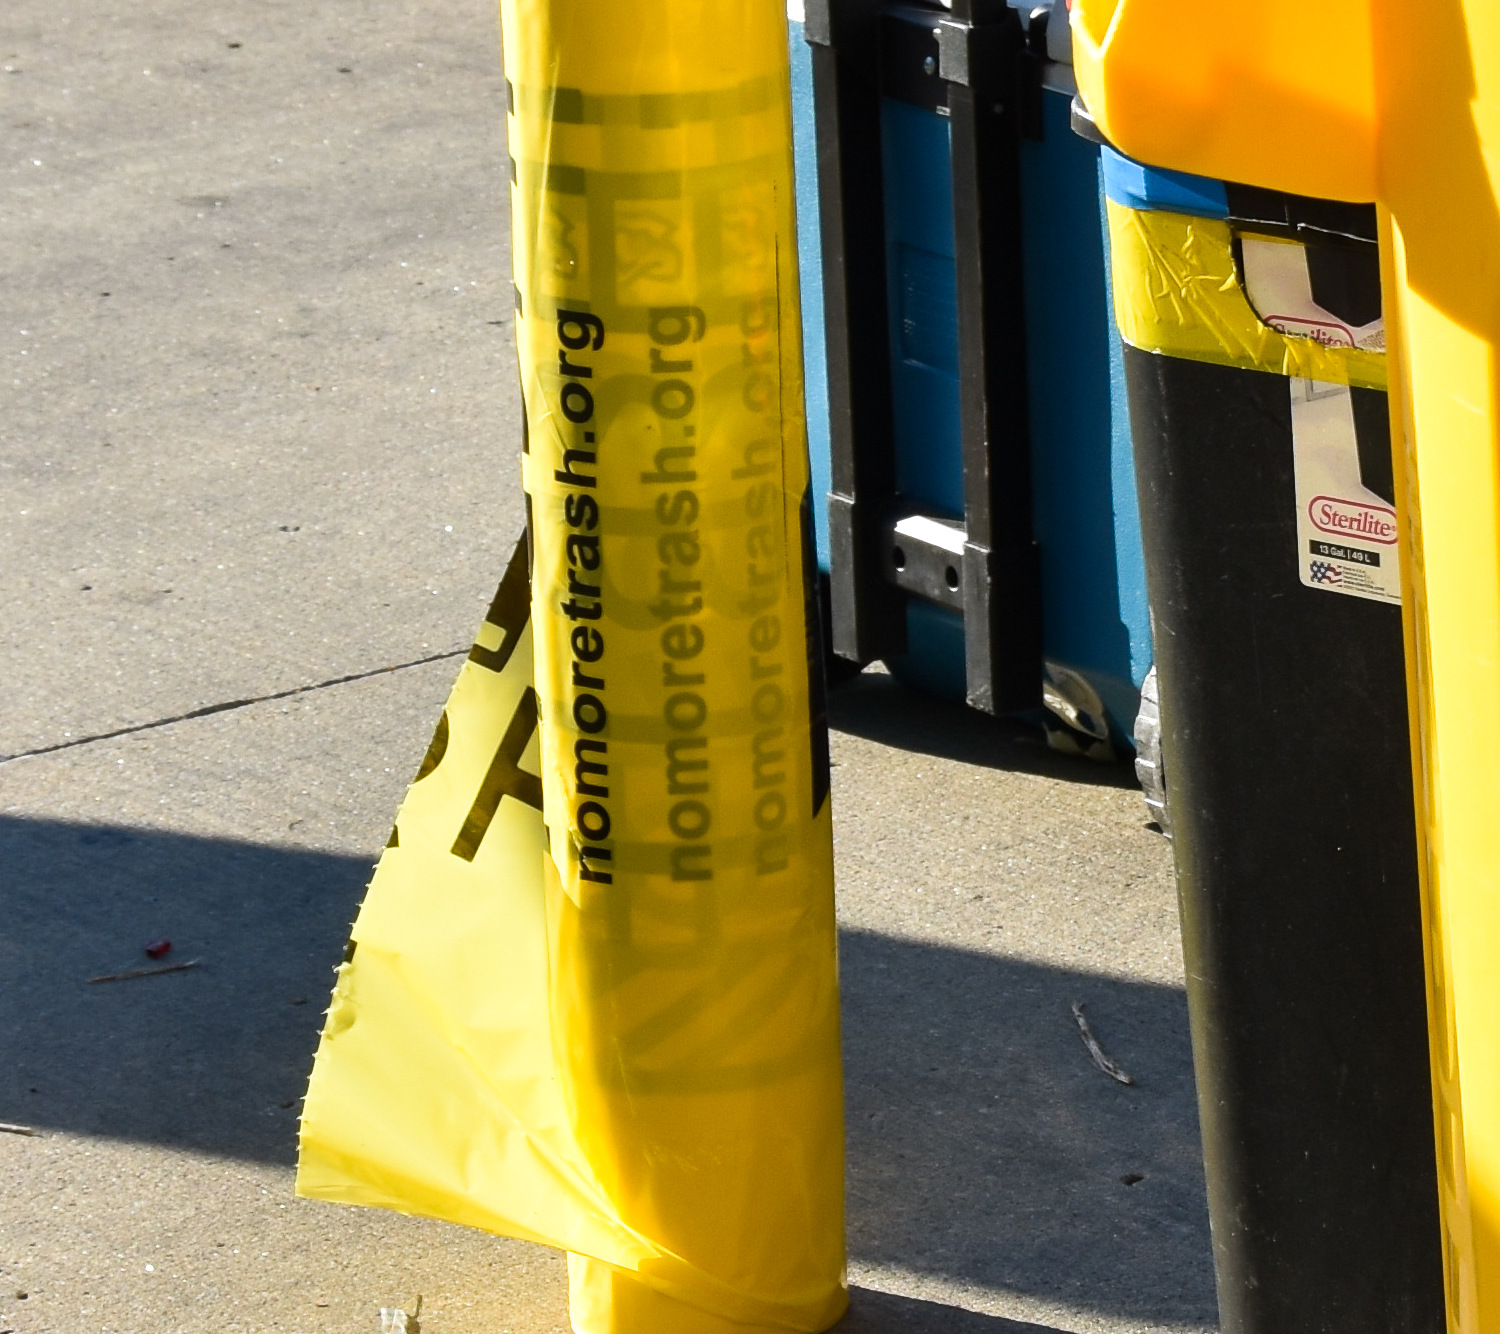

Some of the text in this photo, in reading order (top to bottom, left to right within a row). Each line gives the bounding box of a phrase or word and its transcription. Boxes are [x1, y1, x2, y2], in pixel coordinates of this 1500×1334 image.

[555, 309, 614, 885] nomoretrash.org
[639, 304, 714, 884] nomoretrash.org
[1319, 503, 1390, 537] Sterilite
[1319, 544, 1329, 554] 13
